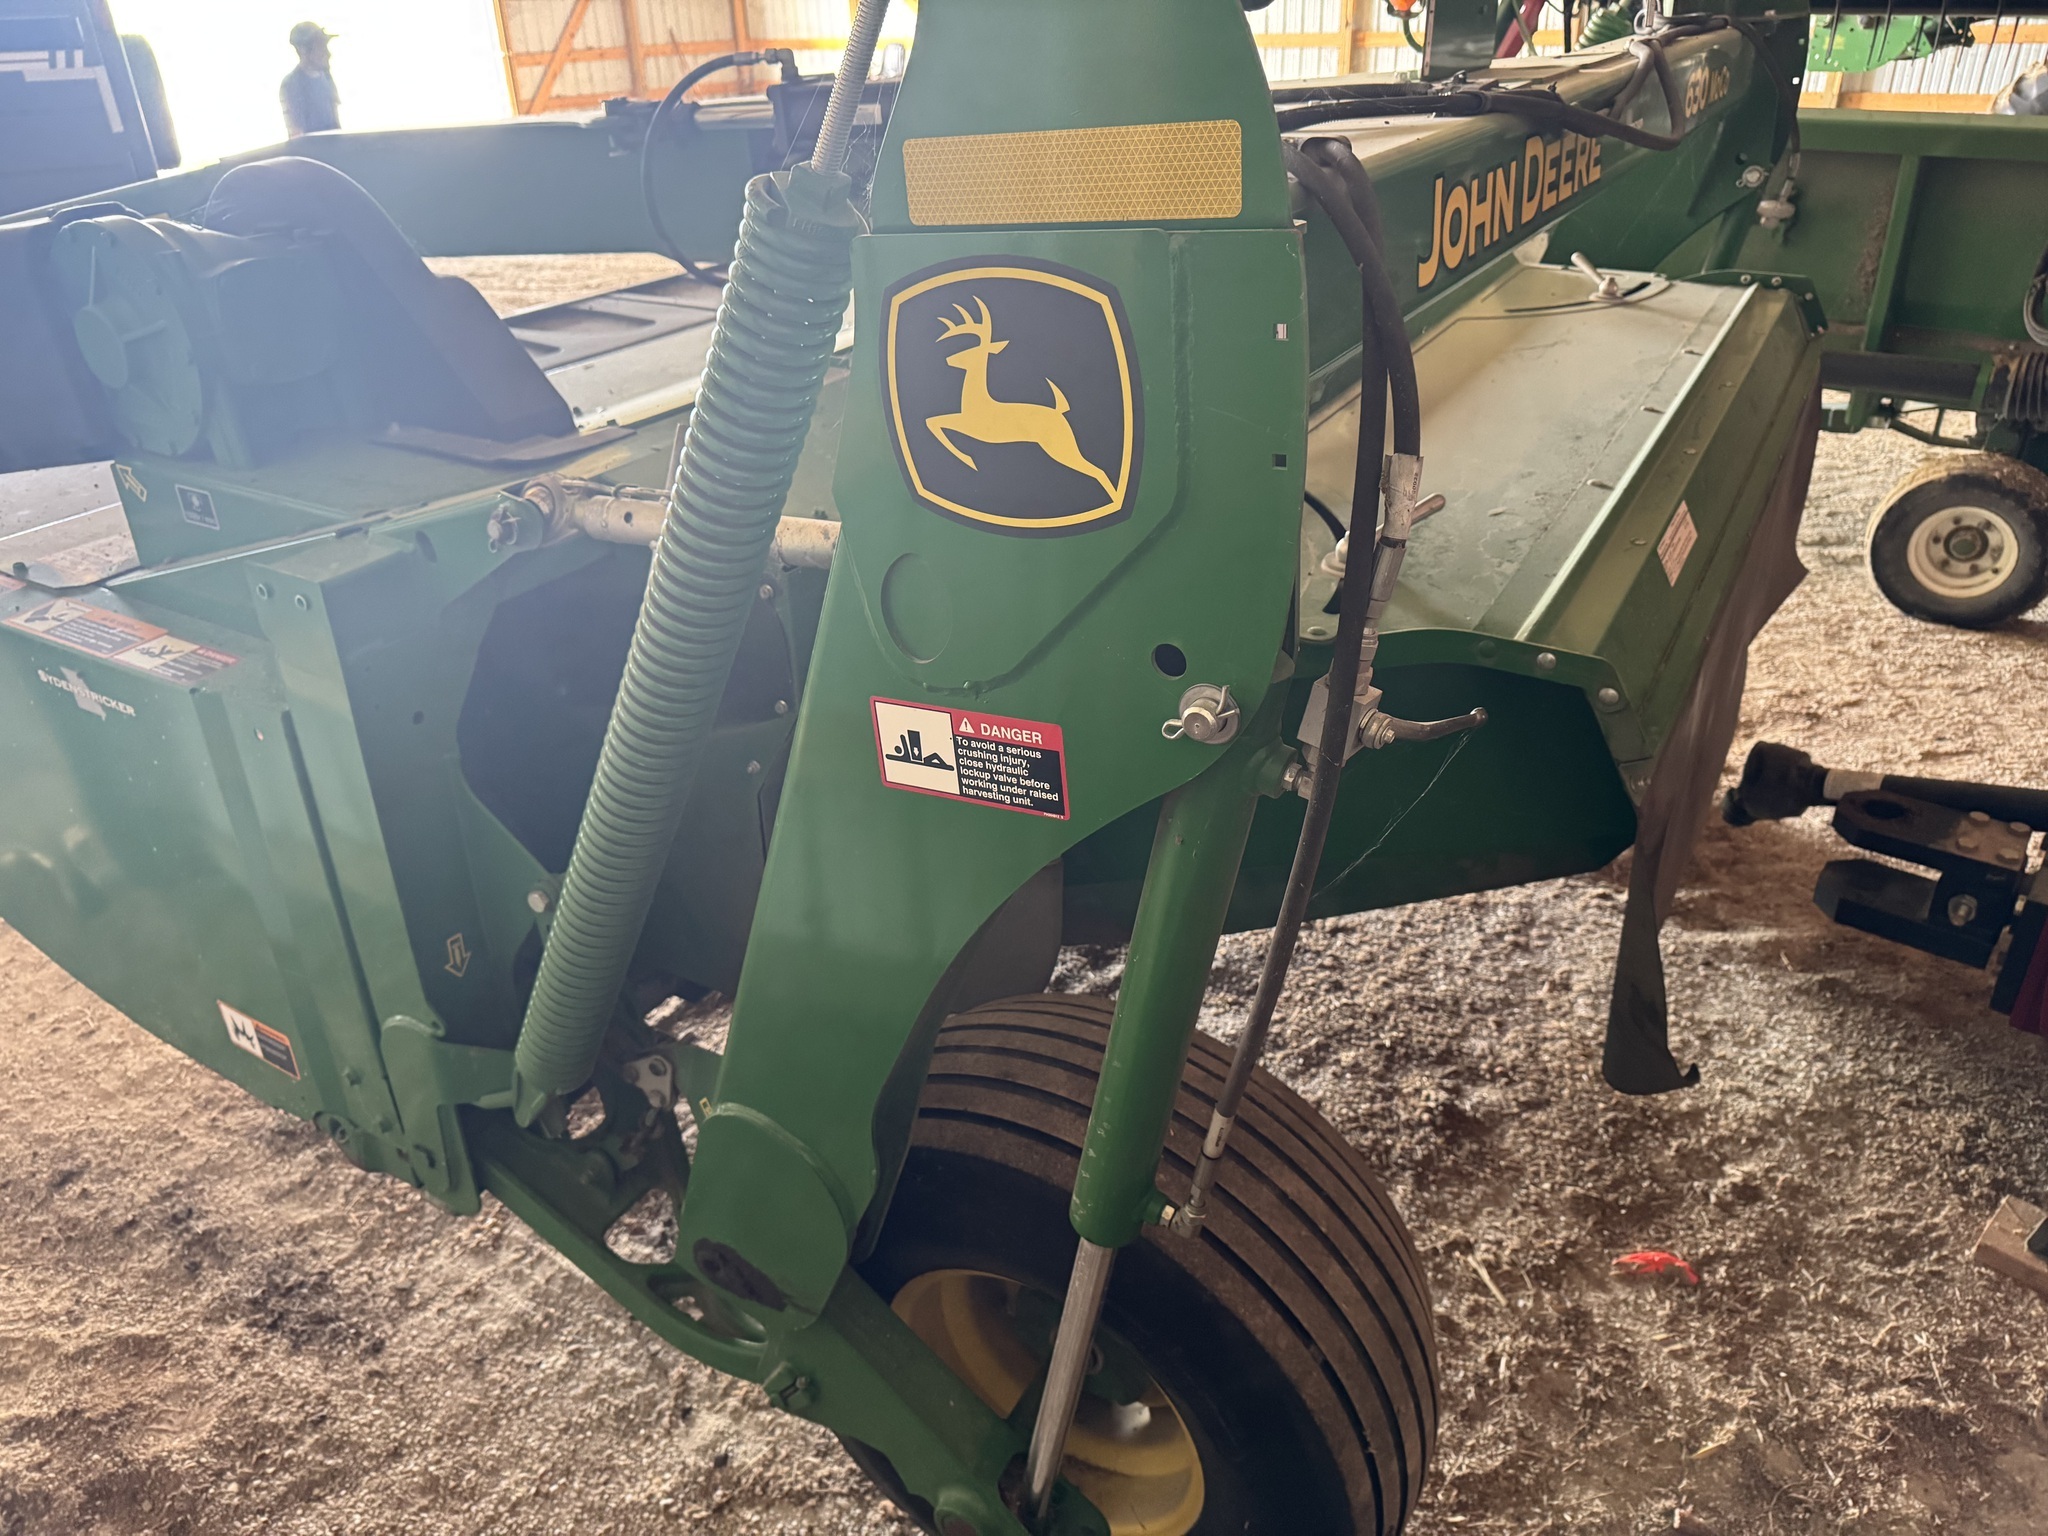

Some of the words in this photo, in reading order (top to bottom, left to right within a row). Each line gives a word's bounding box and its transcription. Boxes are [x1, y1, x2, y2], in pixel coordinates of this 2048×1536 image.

[1685, 66, 1709, 118] 630
[1418, 161, 1516, 288] JOHN
[1521, 131, 1601, 224] DEERE
[37, 669, 136, 717] SYDENSTRICKER
[980, 723, 1042, 745] DANGER
[956, 736, 969, 747] To
[971, 739, 996, 752] avoid
[998, 744, 1004, 752] a
[1006, 745, 1042, 759] serious
[958, 747, 998, 763] crushing
[1000, 754, 1030, 768] injury,
[959, 757, 983, 769] close
[986, 760, 1029, 777] hydraulic
[960, 766, 990, 781] lockup
[993, 771, 1017, 784] valve
[1020, 776, 1050, 790] before
[961, 777, 998, 792] working
[1000, 783, 1026, 796] under
[1029, 789, 1059, 802] raised
[962, 786, 1010, 804] harvesting
[1012, 796, 1034, 807] unit.
